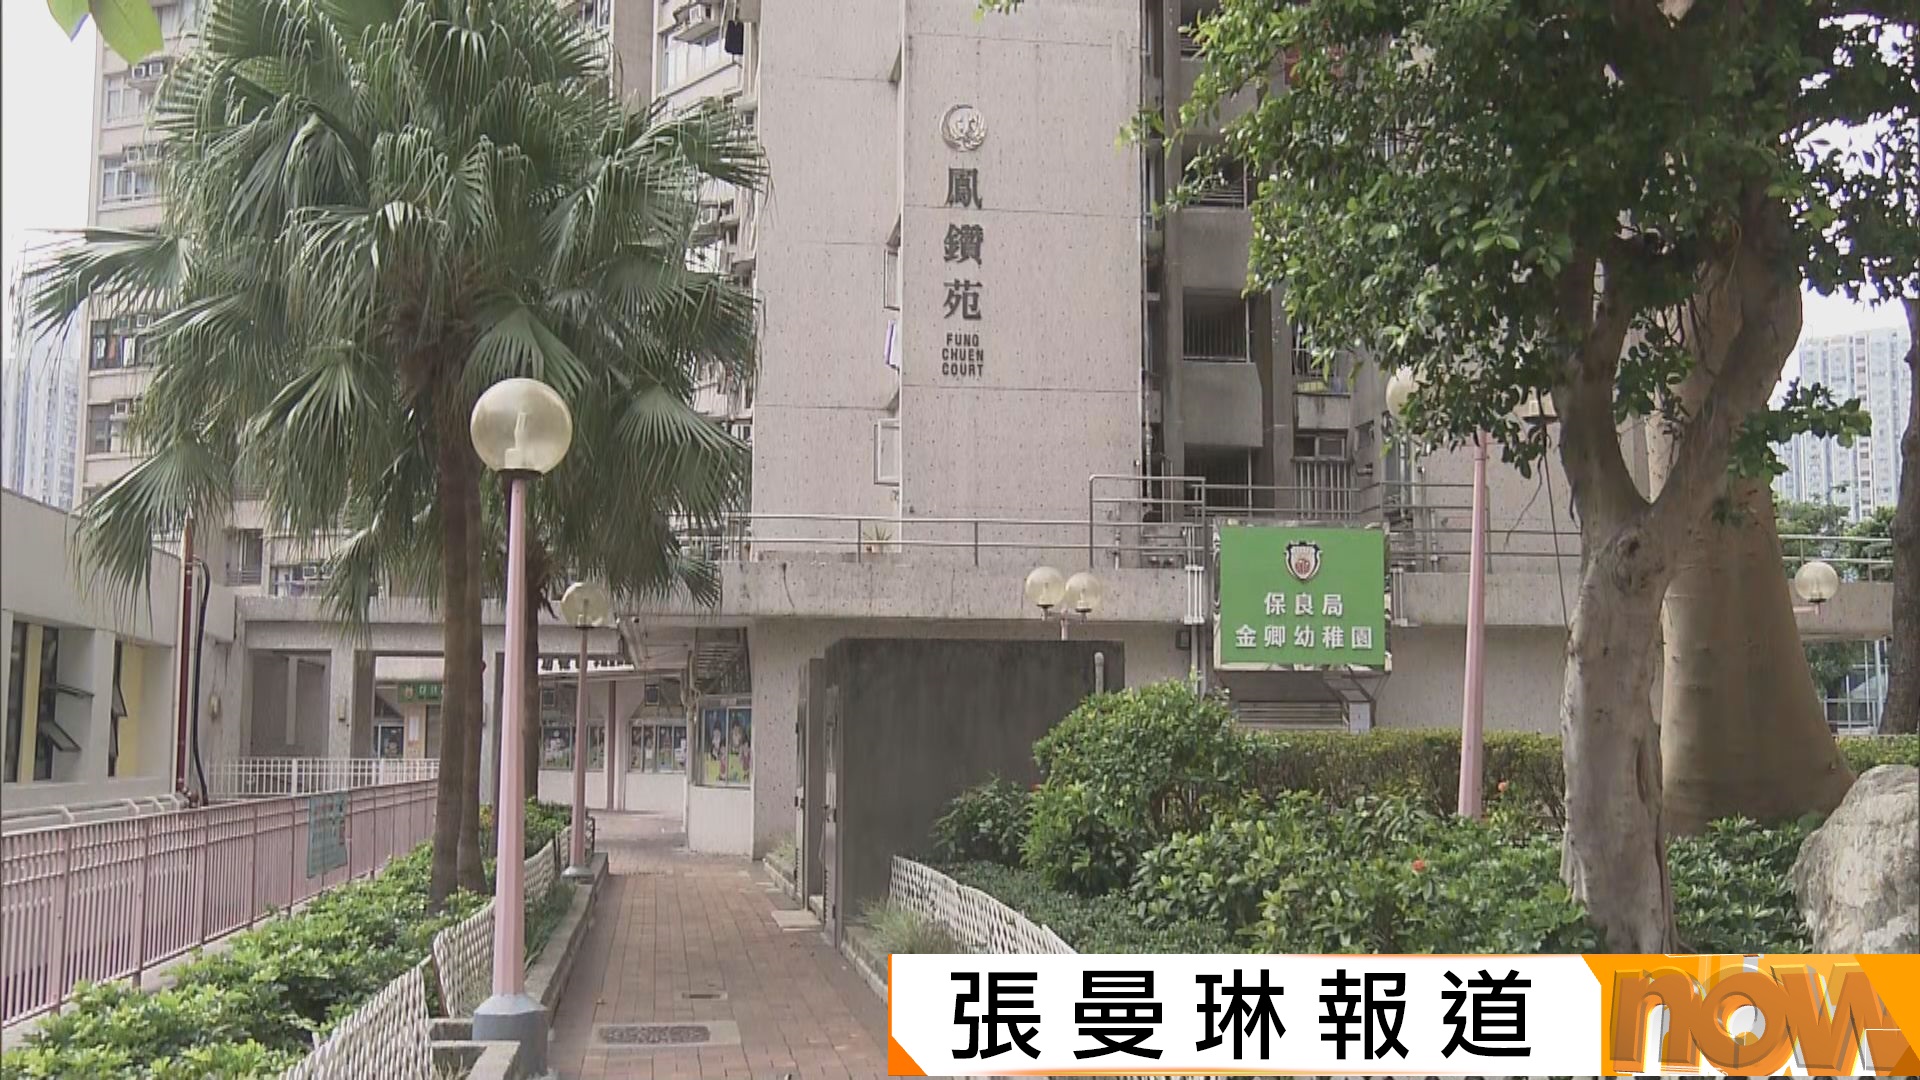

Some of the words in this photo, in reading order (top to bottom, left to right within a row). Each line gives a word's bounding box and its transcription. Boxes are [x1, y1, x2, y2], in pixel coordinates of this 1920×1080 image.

[943, 167, 984, 321] 鳳鑽苑
[942, 347, 984, 361] CHUEN
[942, 362, 984, 377] COURT
[1264, 592, 1343, 616] 保良局
[1235, 624, 1372, 649] 金卿幼稚園
